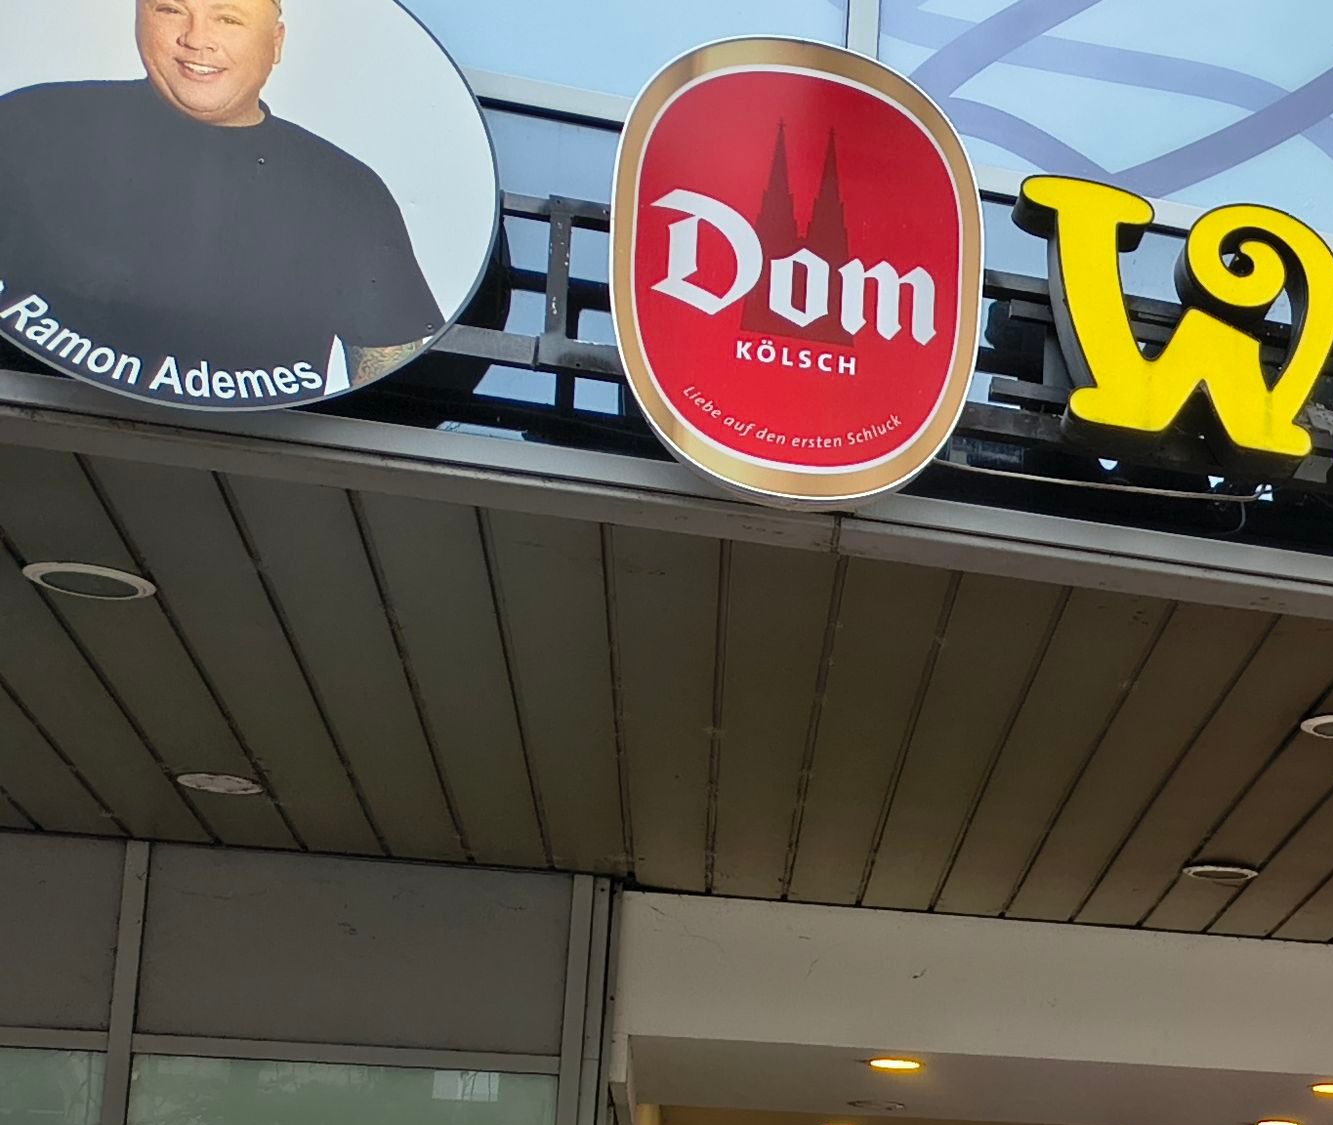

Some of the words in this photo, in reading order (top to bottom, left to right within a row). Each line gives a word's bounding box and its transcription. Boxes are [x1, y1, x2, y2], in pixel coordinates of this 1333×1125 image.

[650, 188, 937, 346] Dom
[0, 294, 142, 385] Ramon
[149, 355, 323, 399] Ademes
[736, 340, 856, 376] KÖLSCH
[683, 386, 722, 419] Liebe
[723, 415, 756, 437] auf
[756, 427, 786, 445] den
[791, 436, 842, 449] ersten
[847, 413, 902, 446] Schluck
